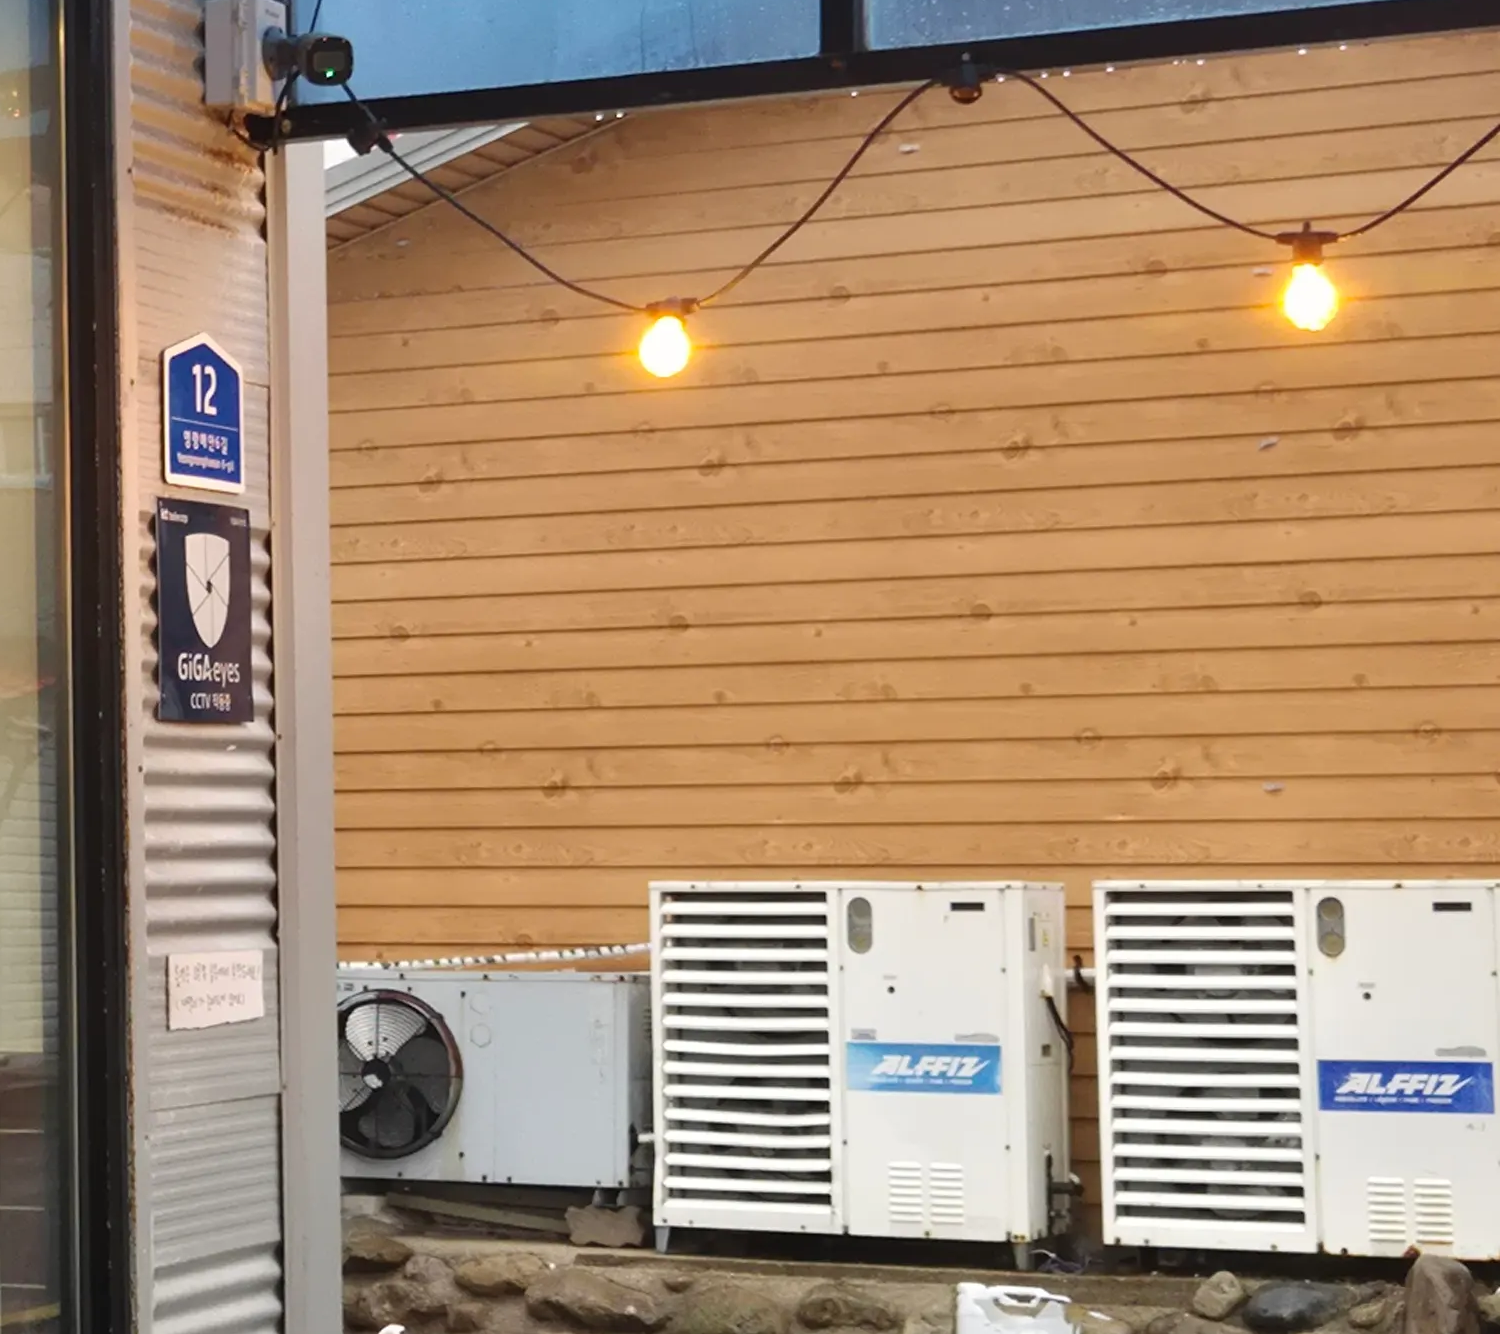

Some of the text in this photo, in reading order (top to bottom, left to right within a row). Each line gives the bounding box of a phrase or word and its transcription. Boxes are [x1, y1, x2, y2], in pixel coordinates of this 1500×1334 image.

[192, 364, 217, 416] 12
[190, 692, 211, 709] CCTV
[871, 1054, 990, 1078] ALFFIZ
[1335, 1072, 1473, 1096] ALFFIZ
